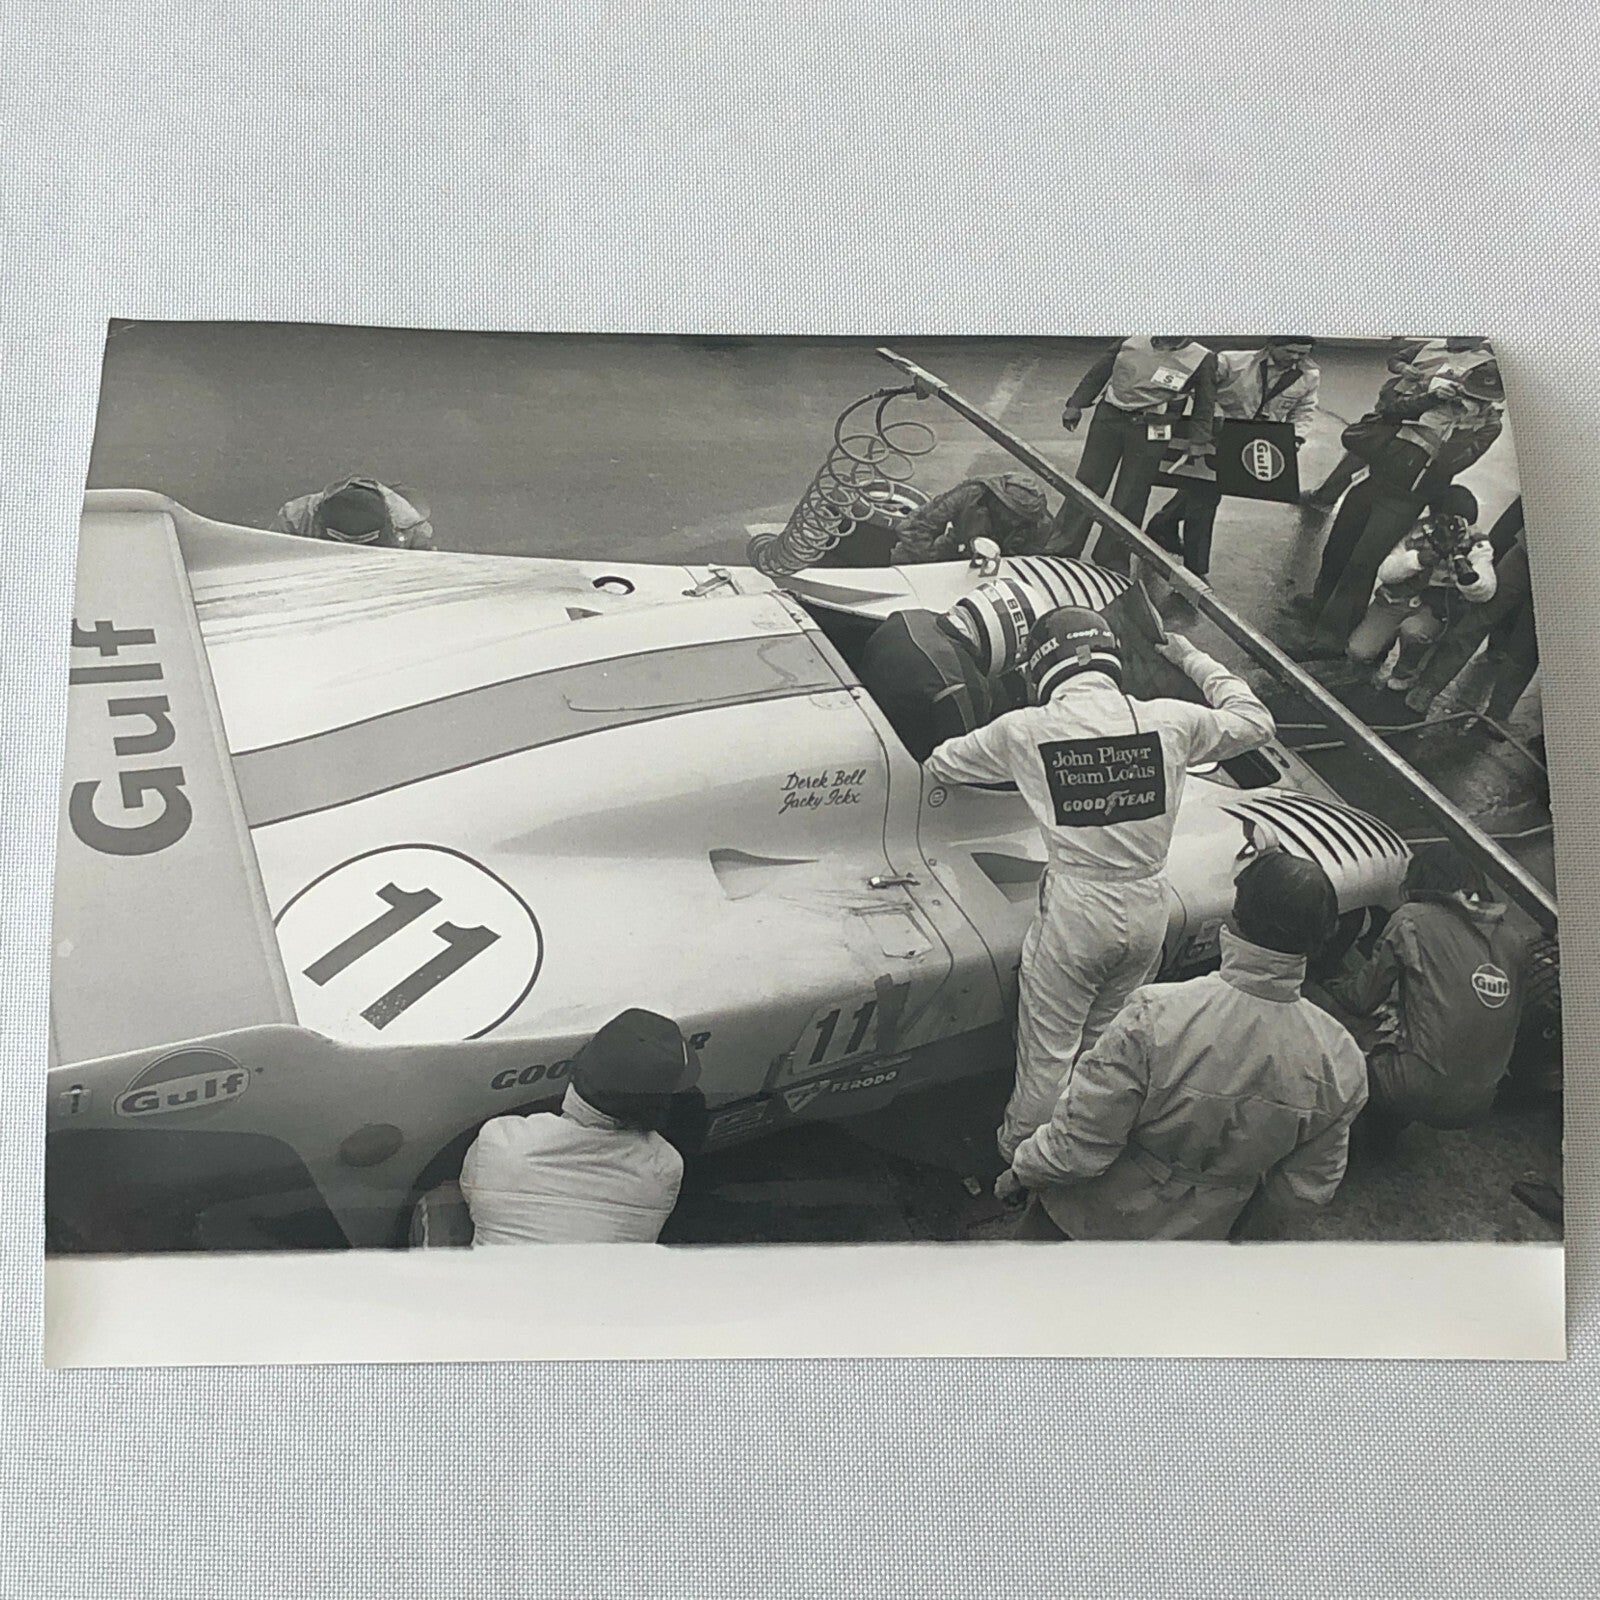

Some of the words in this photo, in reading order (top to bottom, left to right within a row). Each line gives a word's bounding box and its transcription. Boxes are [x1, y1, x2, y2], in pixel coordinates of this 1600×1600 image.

[1256, 442, 1269, 478] Gulf
[69, 617, 192, 856] Gulf
[1053, 750, 1094, 768] John
[781, 770, 828, 791] Derek
[831, 769, 867, 787] Bell
[1055, 769, 1105, 785] Team
[778, 791, 823, 815] Jacky
[824, 788, 860, 806] Ickx
[1063, 789, 1156, 816] GOODYEAR
[302, 881, 501, 1030] 11
[1474, 975, 1508, 995] Gulf
[808, 1001, 878, 1065] 11
[121, 1073, 244, 1113] Gulf
[831, 1071, 897, 1093] FERODO
